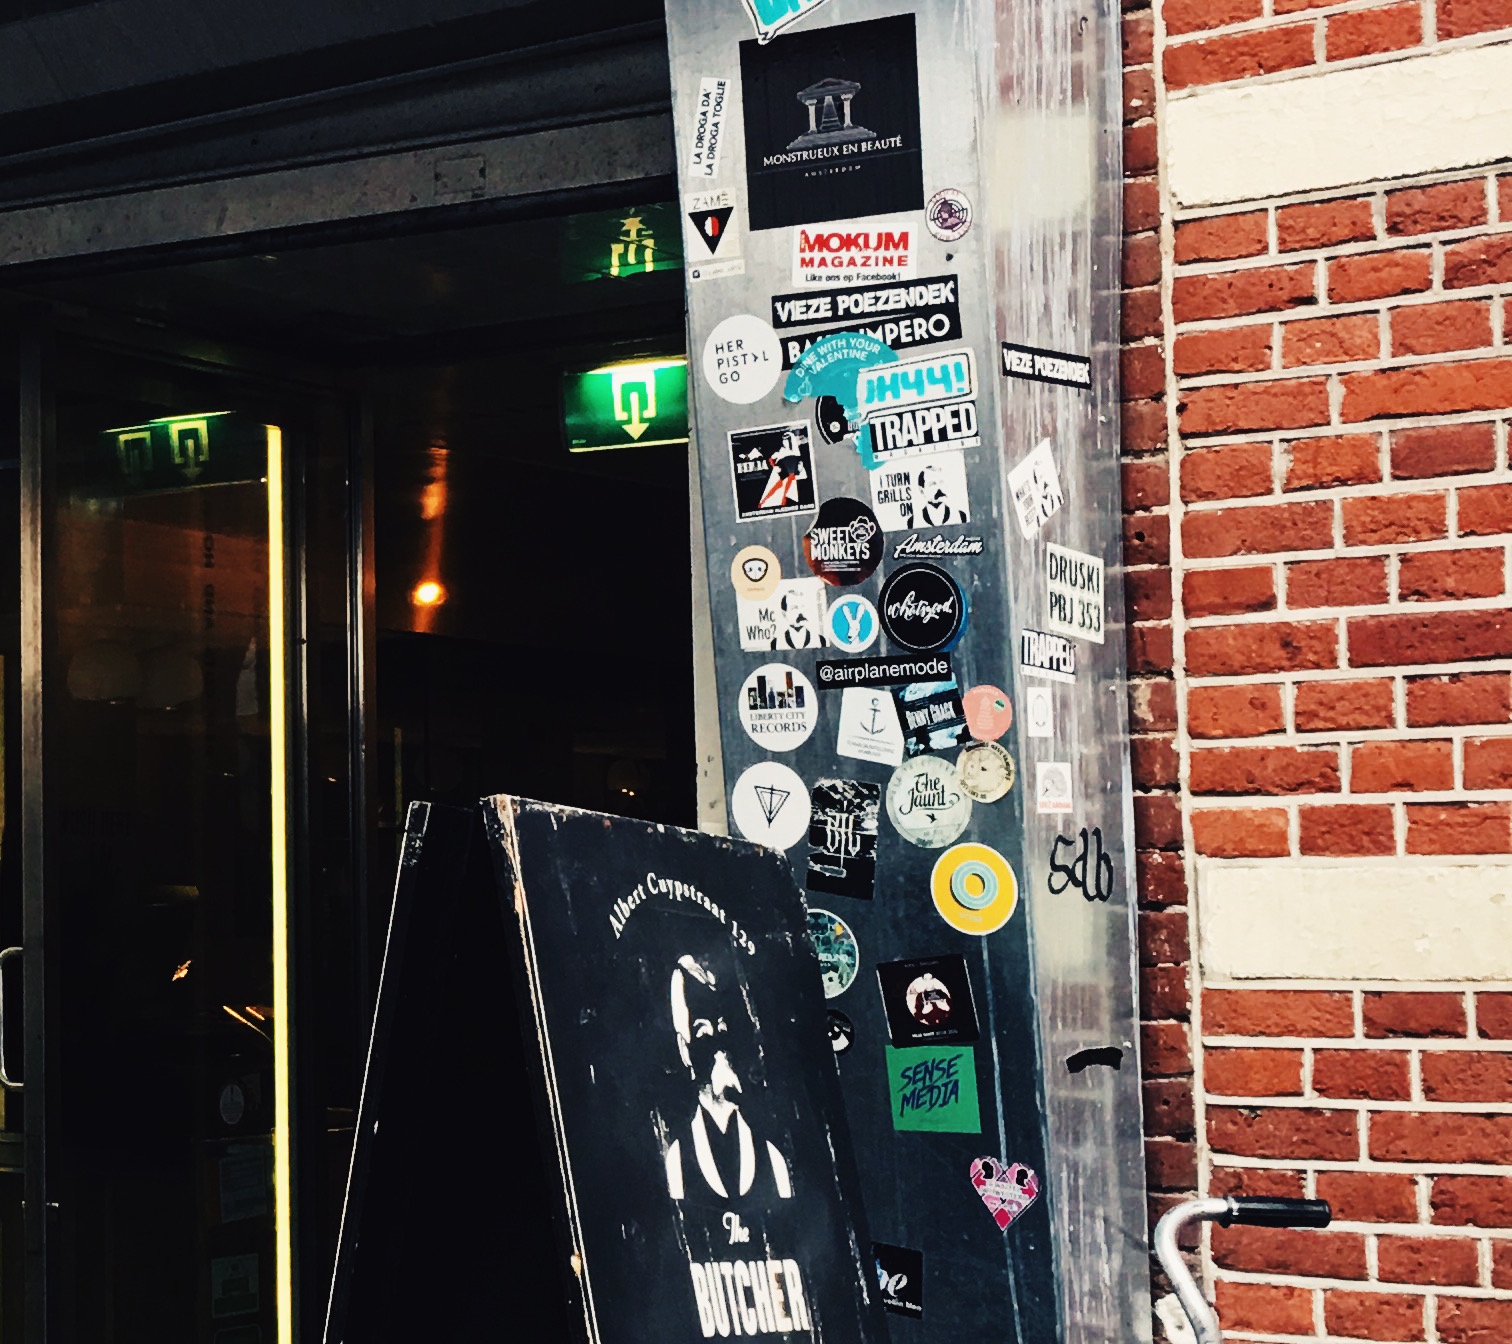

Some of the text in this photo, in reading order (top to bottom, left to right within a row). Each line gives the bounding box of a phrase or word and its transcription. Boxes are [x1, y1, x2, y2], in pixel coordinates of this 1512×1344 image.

[695, 112, 708, 148] DROGA
[707, 121, 719, 158] DROGA
[713, 81, 727, 119] TOGLIE
[763, 134, 903, 167] MONSTRUEUX EN BEAUTÉ
[800, 229, 909, 253] MOKUM
[800, 255, 909, 268] MAGAZINE
[774, 280, 955, 322] VIEZE POEZENDEK
[715, 339, 744, 355] HER
[817, 338, 847, 354] WITH
[850, 338, 881, 355] YOUR
[809, 349, 868, 375] VALENTINE
[1003, 348, 1091, 384] VIEZE POEZENDEK
[719, 371, 740, 384] GO
[870, 402, 978, 452] TRAPPED
[886, 472, 911, 488] TURN
[899, 502, 913, 517] ON
[810, 527, 850, 544] SWEET
[893, 534, 984, 559] Amsterdam
[810, 543, 870, 561] MONKEYS
[1049, 552, 1100, 594] DRUSKI
[758, 608, 775, 623] Mc
[1050, 591, 1101, 632] PBJ 353
[746, 624, 777, 641] Who?
[1022, 630, 1075, 674] TRAPPED
[819, 658, 948, 683] @airplanemode
[751, 722, 807, 734] RECORDS
[914, 773, 941, 793] The
[899, 788, 955, 815] Jaunt
[609, 872, 756, 956] Albert Cuypstraat 129
[898, 1054, 964, 1091] SENSE
[899, 1079, 960, 1118] MEDIA
[722, 1212, 749, 1245] The
[690, 1258, 811, 1338] BUTCHER
